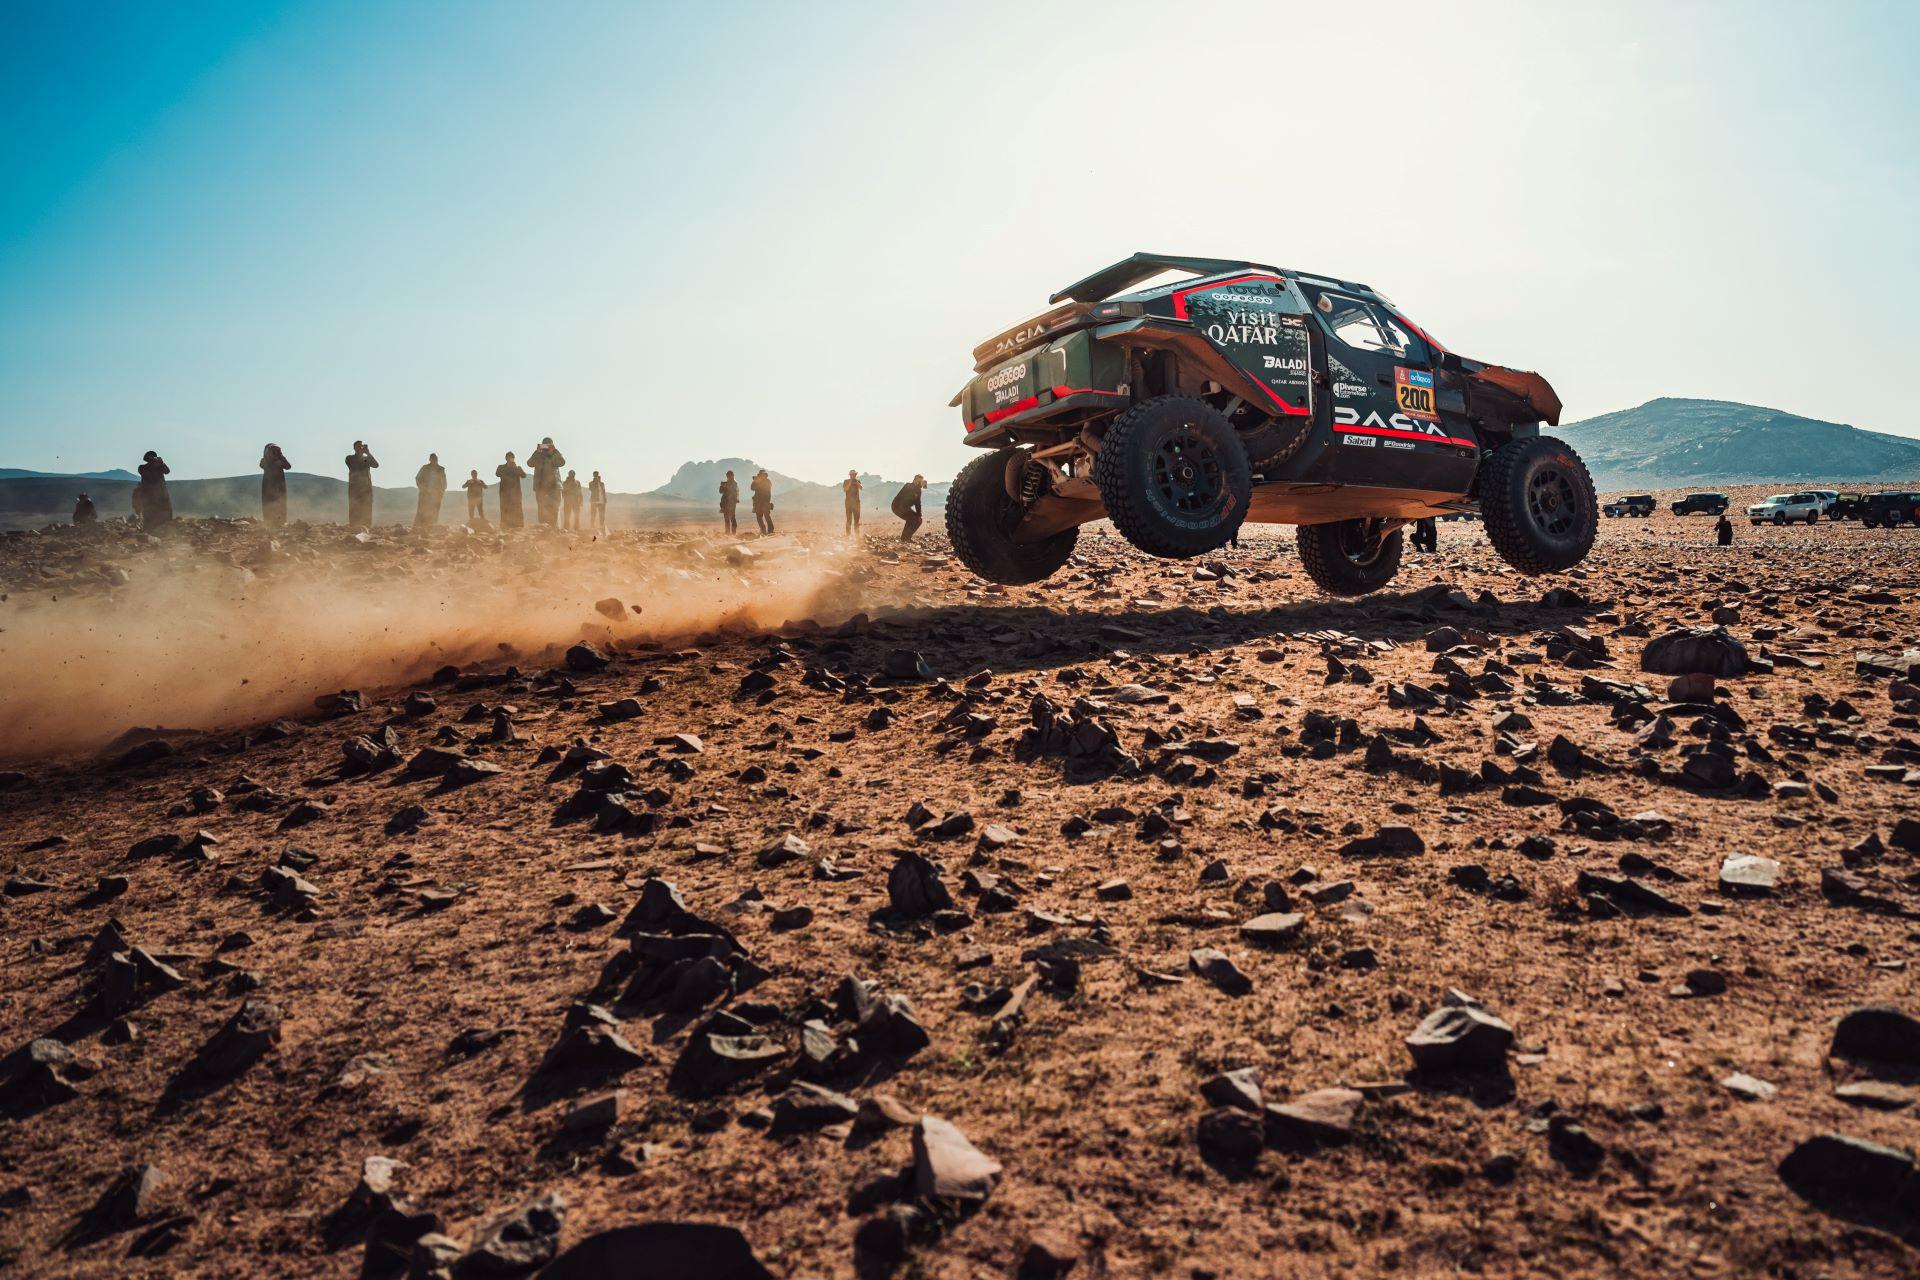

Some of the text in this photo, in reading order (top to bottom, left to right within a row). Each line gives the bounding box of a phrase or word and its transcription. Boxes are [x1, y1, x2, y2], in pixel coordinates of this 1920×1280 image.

[1212, 293, 1273, 304] ooredoo
[1228, 308, 1276, 326] visit
[995, 324, 1045, 354] DACIA
[1208, 324, 1278, 347] QATAR
[1263, 355, 1307, 370] BALADI
[987, 363, 1026, 392] ooredoo
[995, 384, 1019, 404] BALADI
[1340, 382, 1367, 393] Diverse
[1400, 386, 1431, 412] 200
[1334, 406, 1447, 437] DACIA
[1346, 435, 1373, 446] Sabelt
[1384, 440, 1416, 449] BFGoodrich
